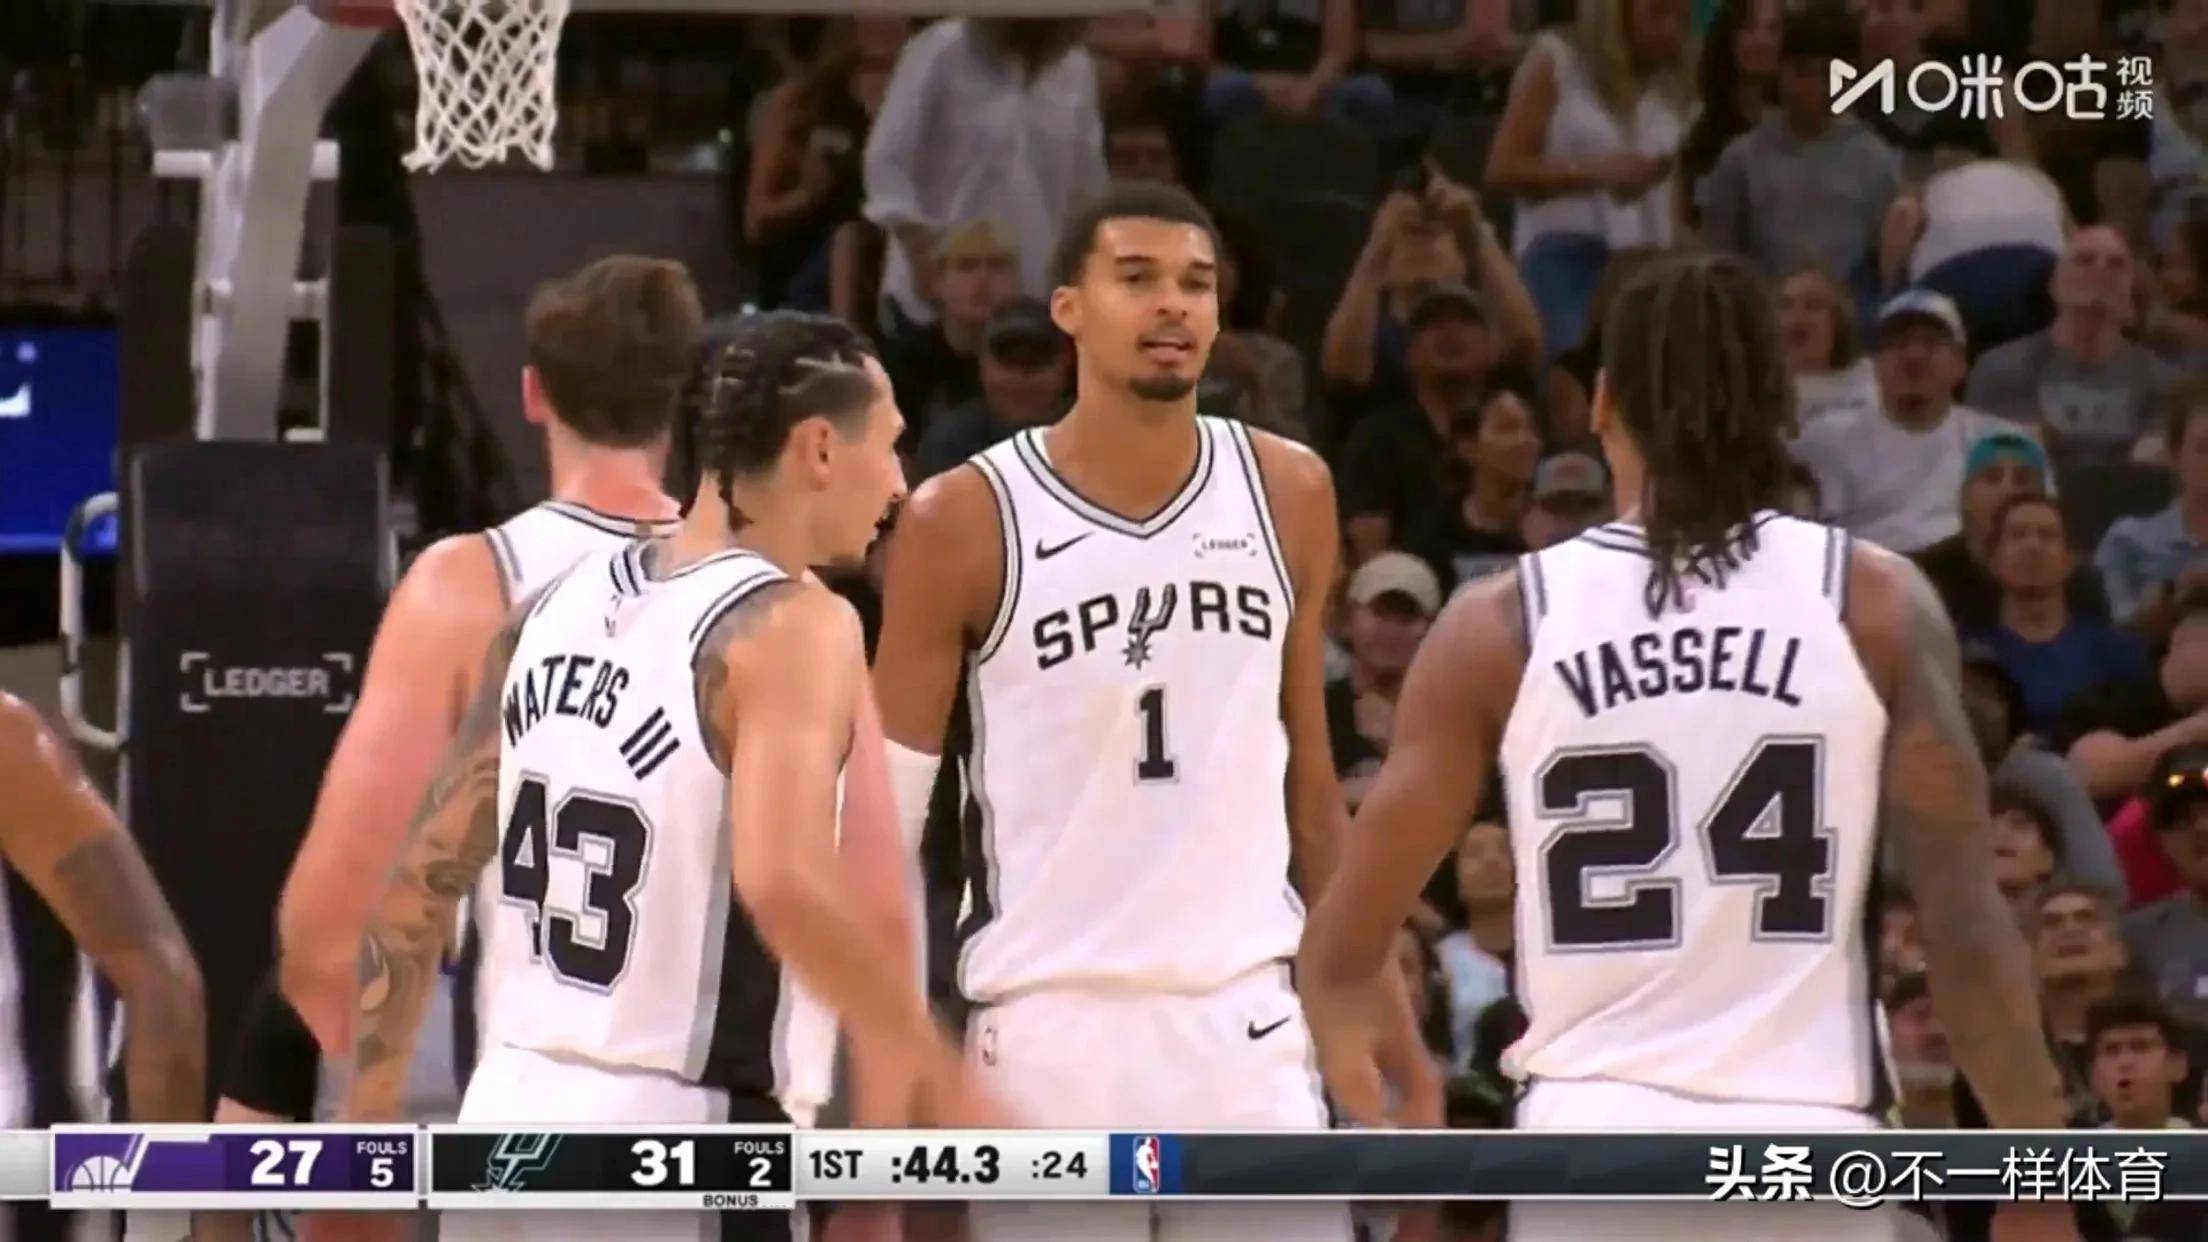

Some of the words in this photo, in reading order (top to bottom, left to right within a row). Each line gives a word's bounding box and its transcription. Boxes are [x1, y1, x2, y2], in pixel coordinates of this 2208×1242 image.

[1032, 580, 1272, 670] SPURS
[1554, 626, 1803, 718] VASSELL
[203, 667, 330, 697] LEDGER
[502, 653, 630, 748] WATERS
[618, 706, 681, 781] III
[1134, 684, 1179, 784] 1
[500, 769, 654, 996] 43
[1534, 734, 1838, 954] 24
